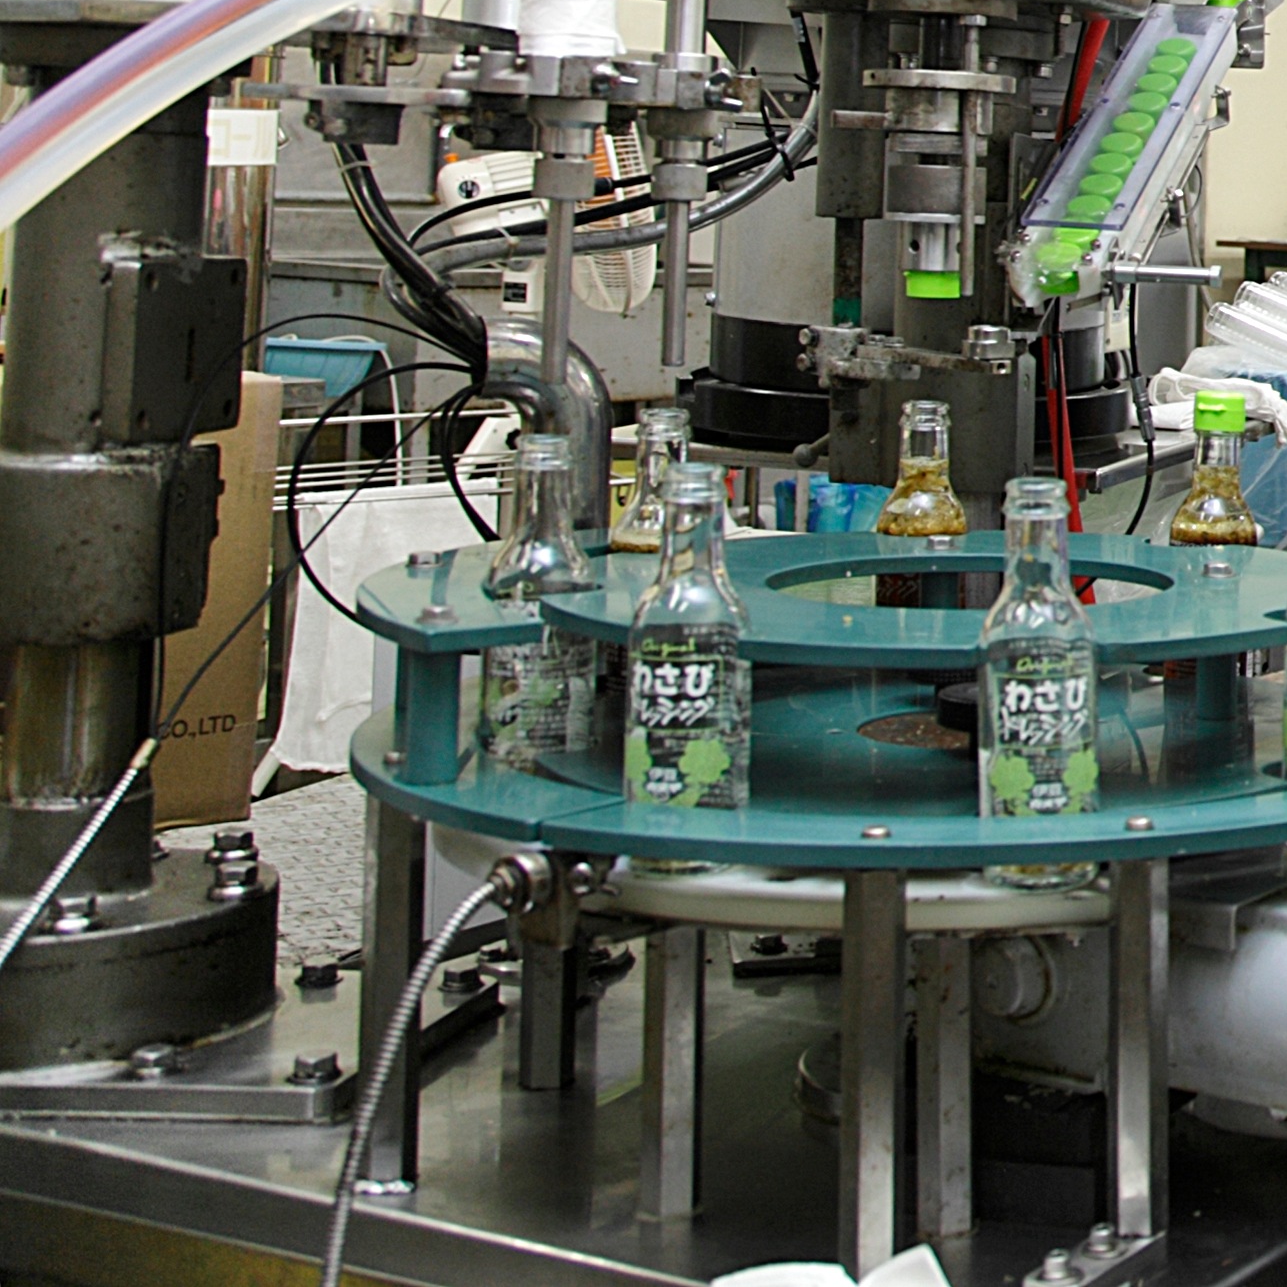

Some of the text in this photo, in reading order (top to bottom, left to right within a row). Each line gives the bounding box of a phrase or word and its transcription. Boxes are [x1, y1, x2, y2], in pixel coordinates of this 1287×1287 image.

[633, 661, 715, 698] わさび
[1004, 676, 1088, 712] わさび
[640, 696, 716, 727] レッシング
